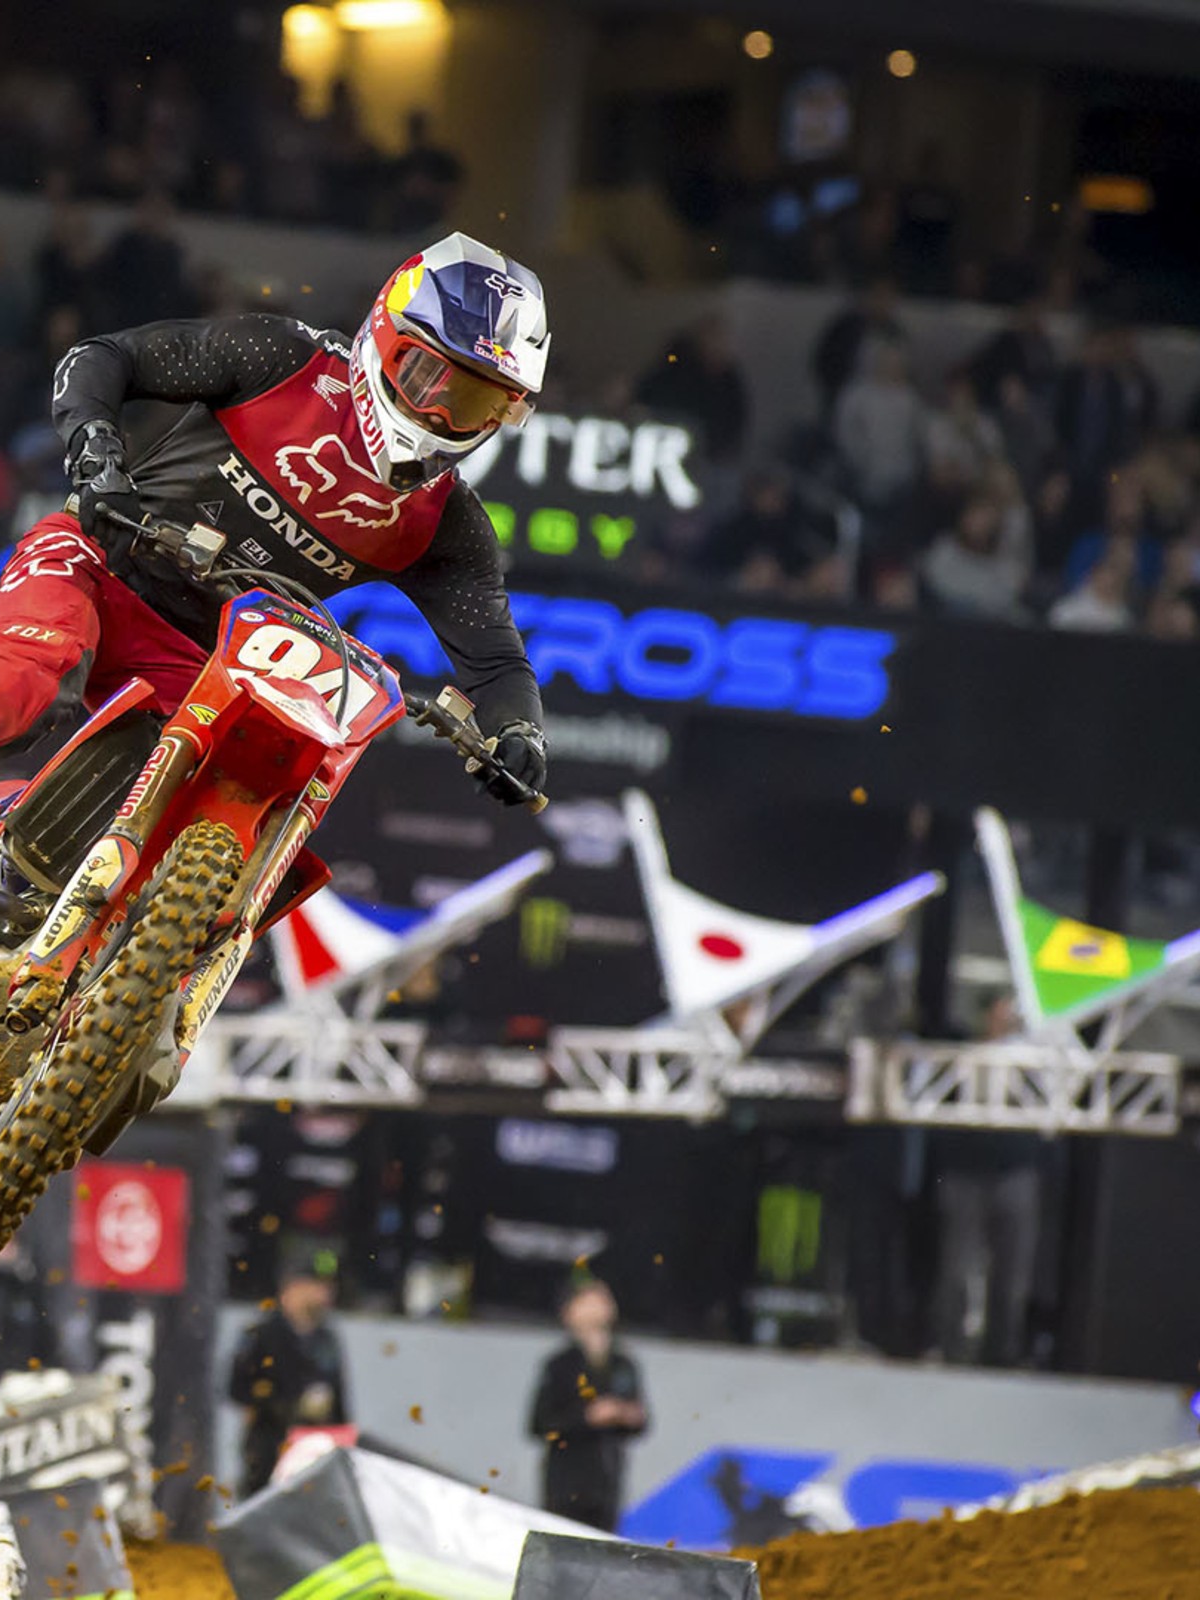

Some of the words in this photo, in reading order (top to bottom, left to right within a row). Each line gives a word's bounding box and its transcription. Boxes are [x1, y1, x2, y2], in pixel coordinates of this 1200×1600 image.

[218, 453, 356, 581] HONDA
[3, 625, 56, 641] FOX
[227, 624, 378, 741] 94
[44, 872, 93, 949] DUNLOP
[197, 943, 243, 1028] DUNLOP
